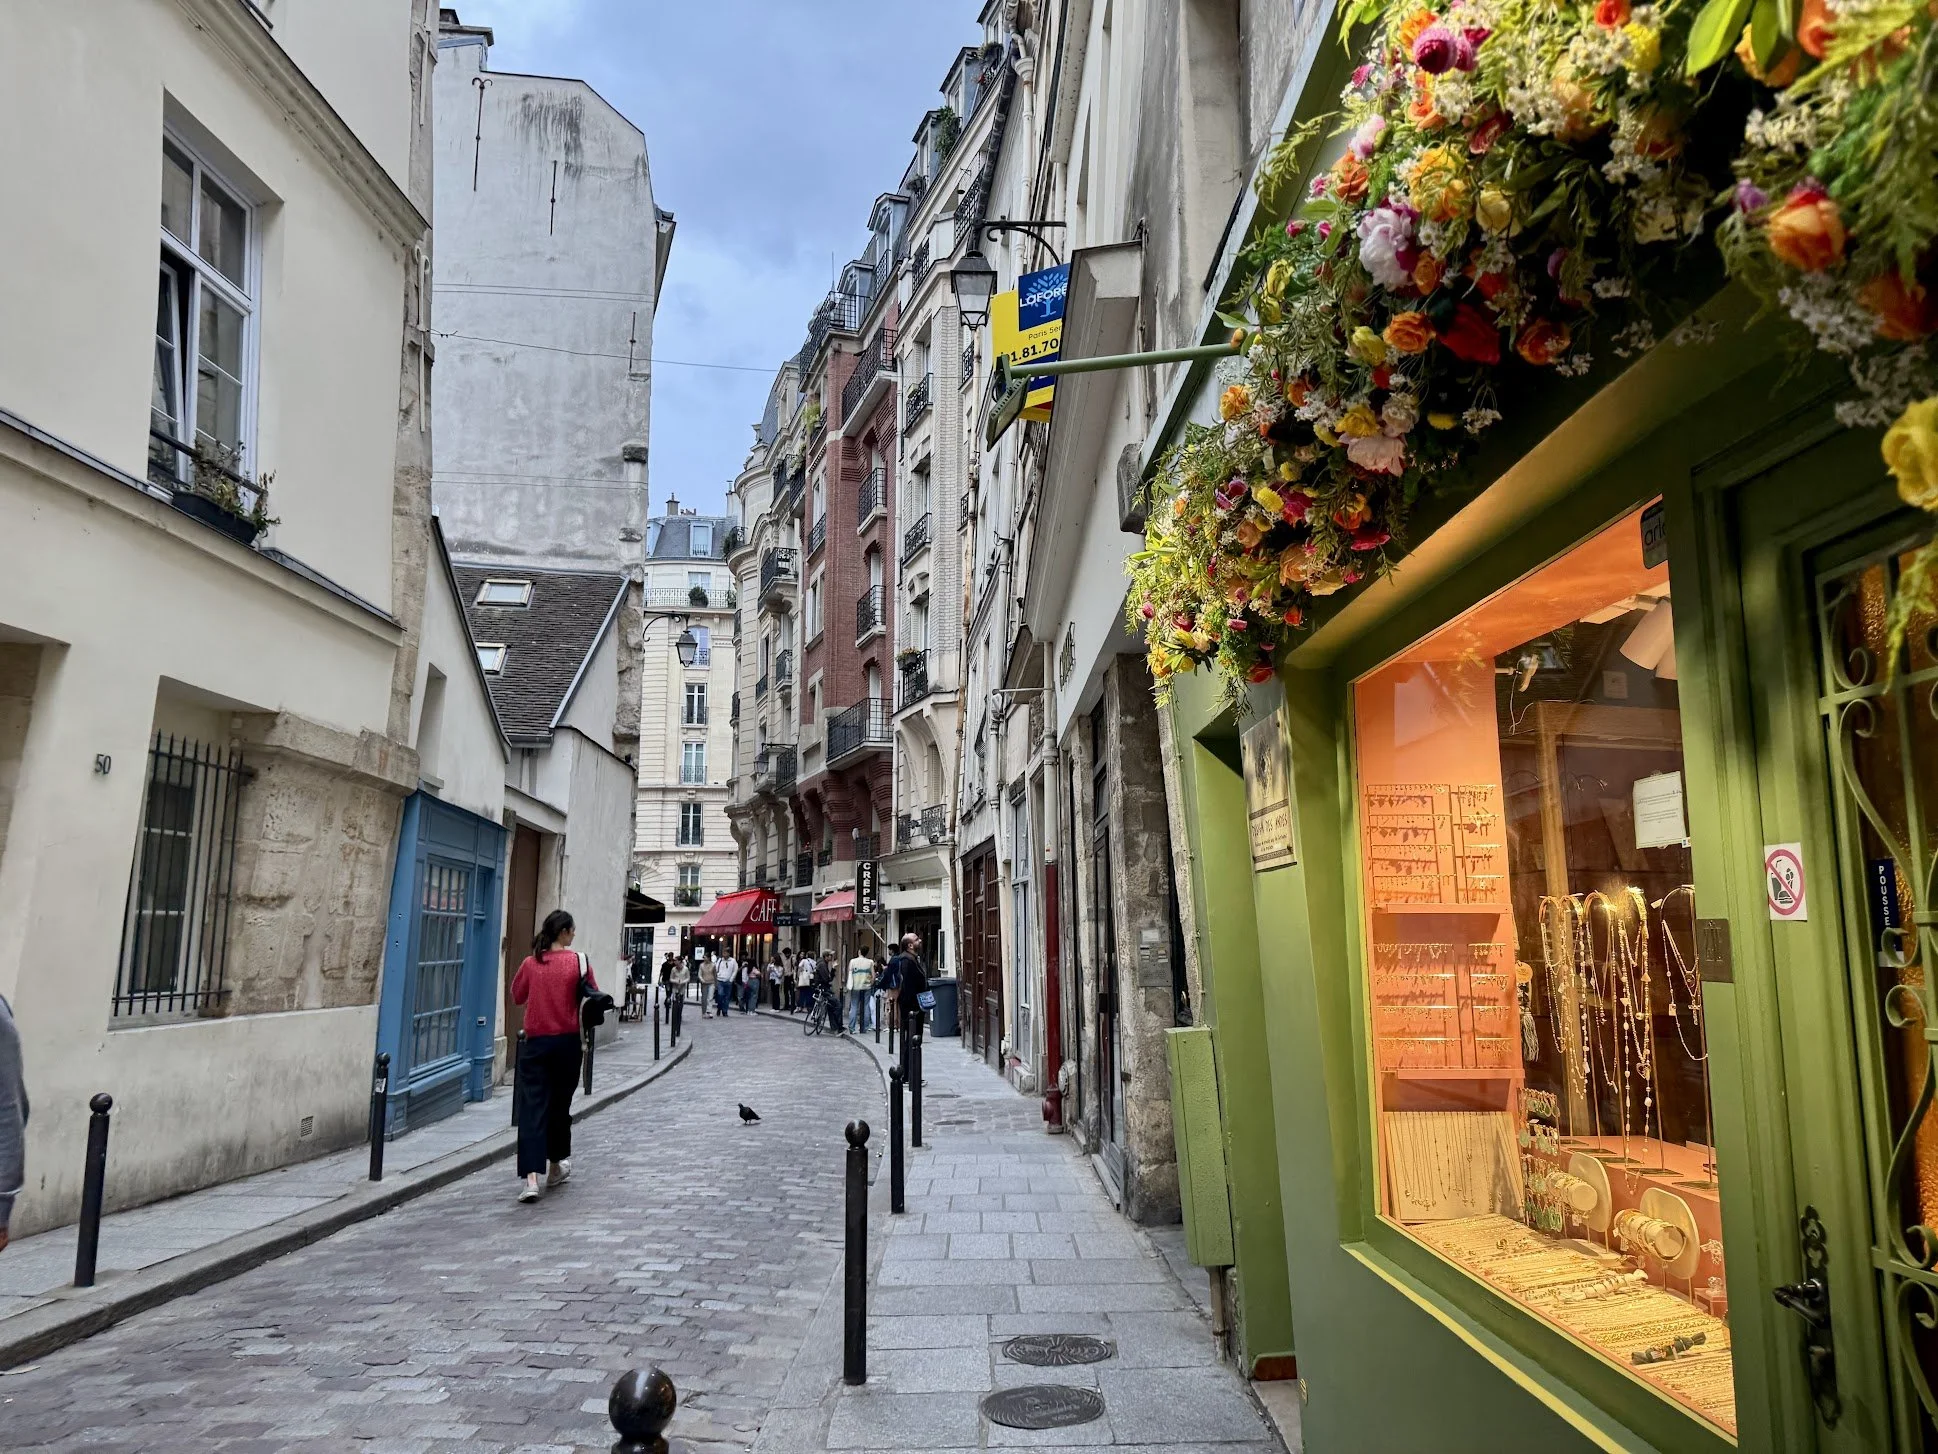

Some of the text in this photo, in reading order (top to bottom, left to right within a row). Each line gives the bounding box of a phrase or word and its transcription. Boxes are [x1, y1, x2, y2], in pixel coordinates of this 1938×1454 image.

[1028, 330, 1048, 340] Paris
[1005, 338, 1059, 362] 1.81.70
[94, 753, 111, 774] 50
[1878, 865, 1891, 930] POUSSE
